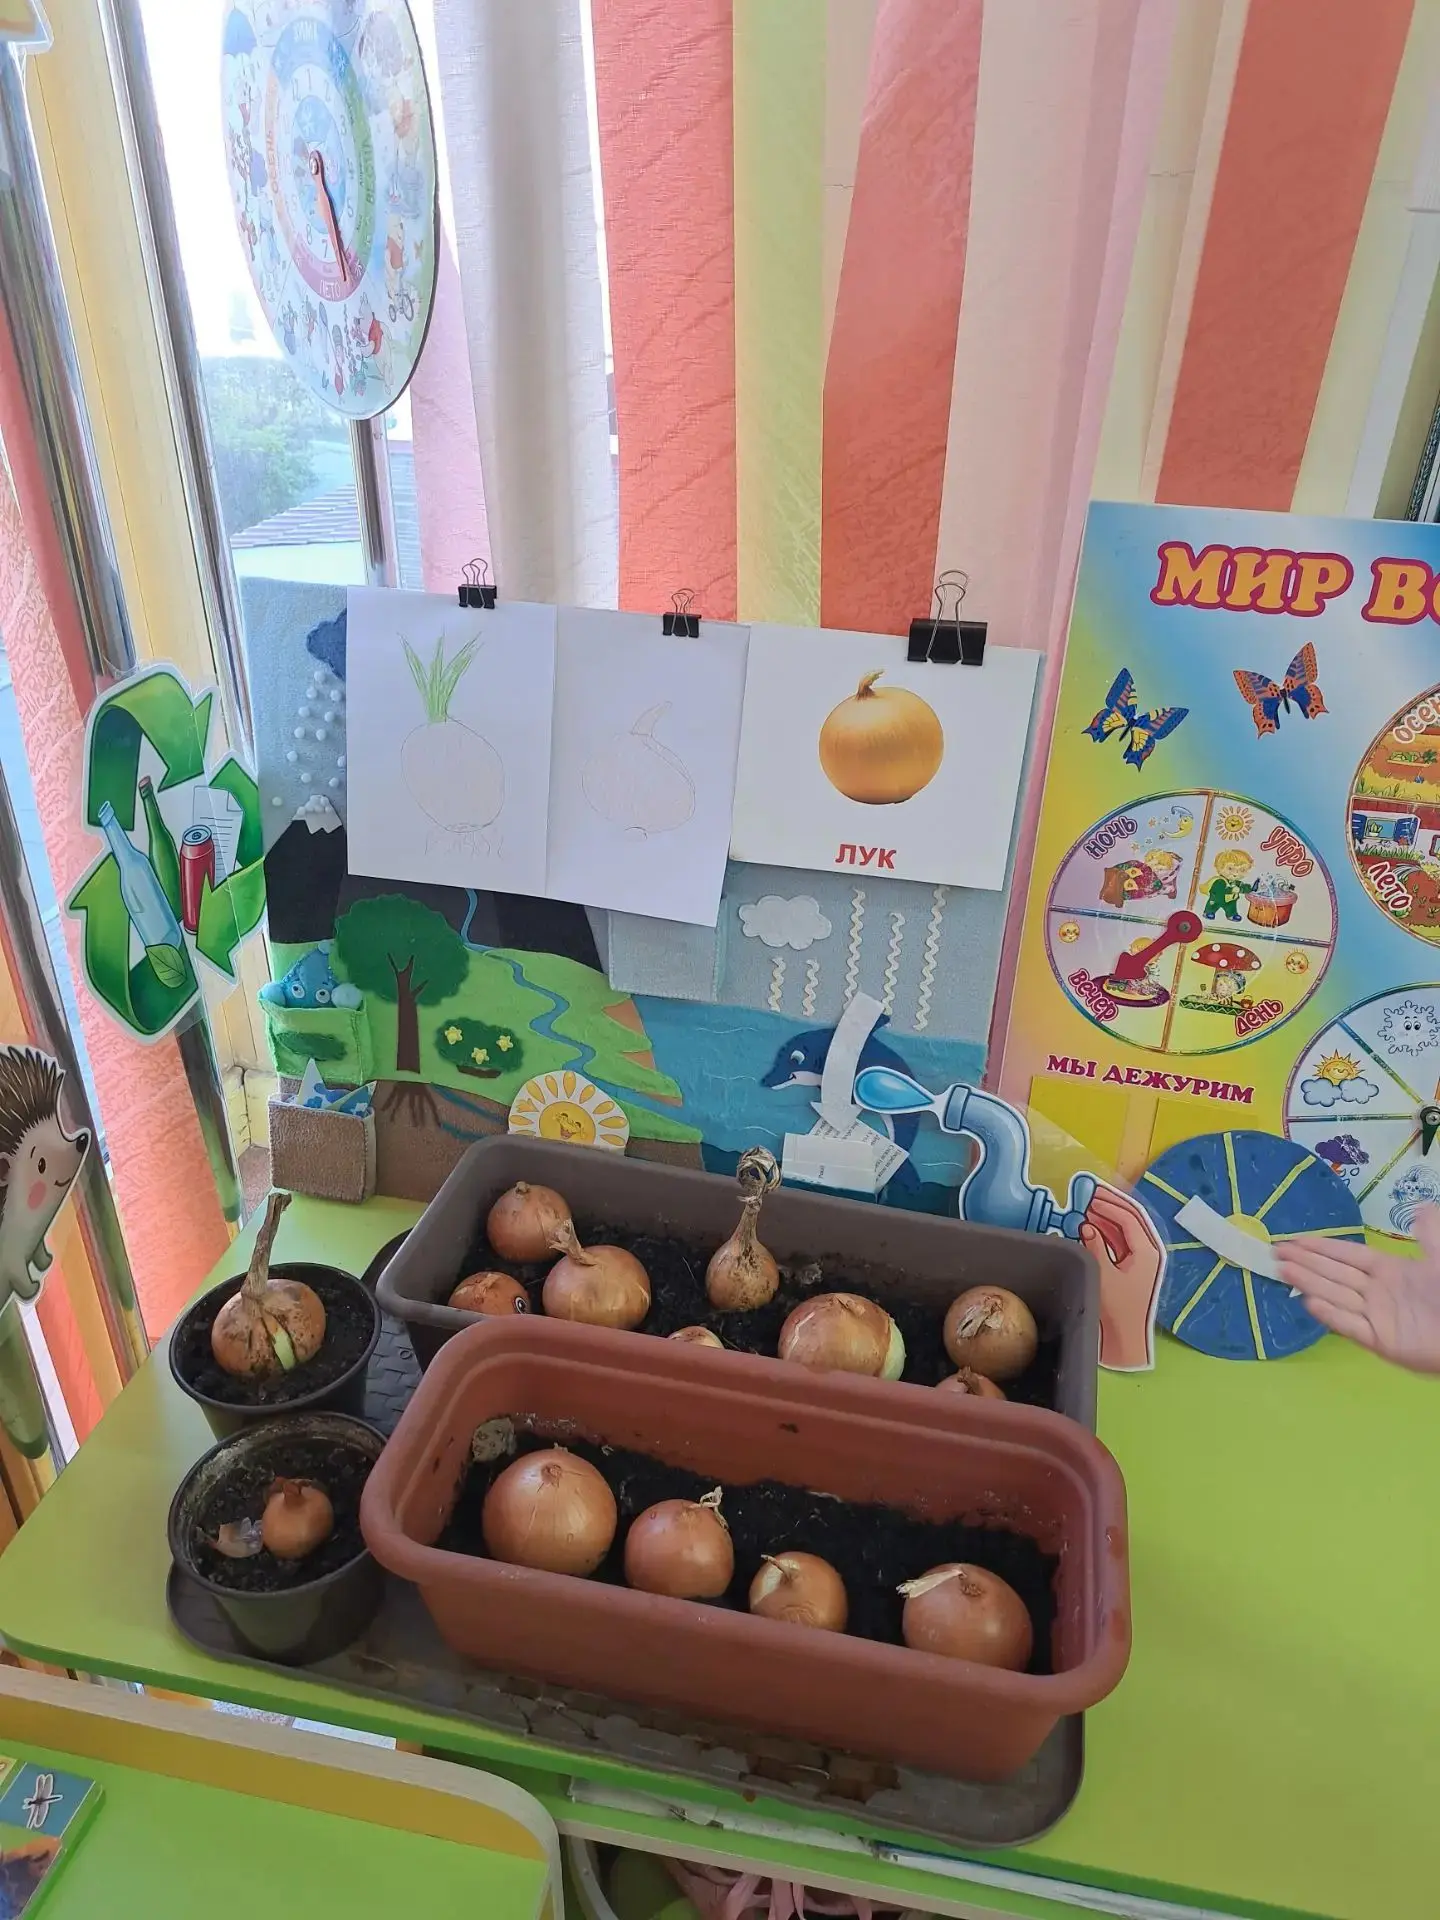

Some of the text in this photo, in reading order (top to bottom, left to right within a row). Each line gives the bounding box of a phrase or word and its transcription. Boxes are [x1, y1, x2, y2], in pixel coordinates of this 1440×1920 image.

[266, 130, 279, 194] ОСЕНЬ
[306, 223, 312, 245] 8
[321, 238, 328, 258] 7
[320, 279, 341, 299] ЛЕТО
[1150, 541, 1440, 625] МИР В
[835, 843, 897, 869] ЛУК
[1083, 816, 1138, 860] НОЧЬ
[1261, 826, 1314, 877] УТРО
[1046, 1054, 1255, 1104] МЫ ДЕЖУРИМ
